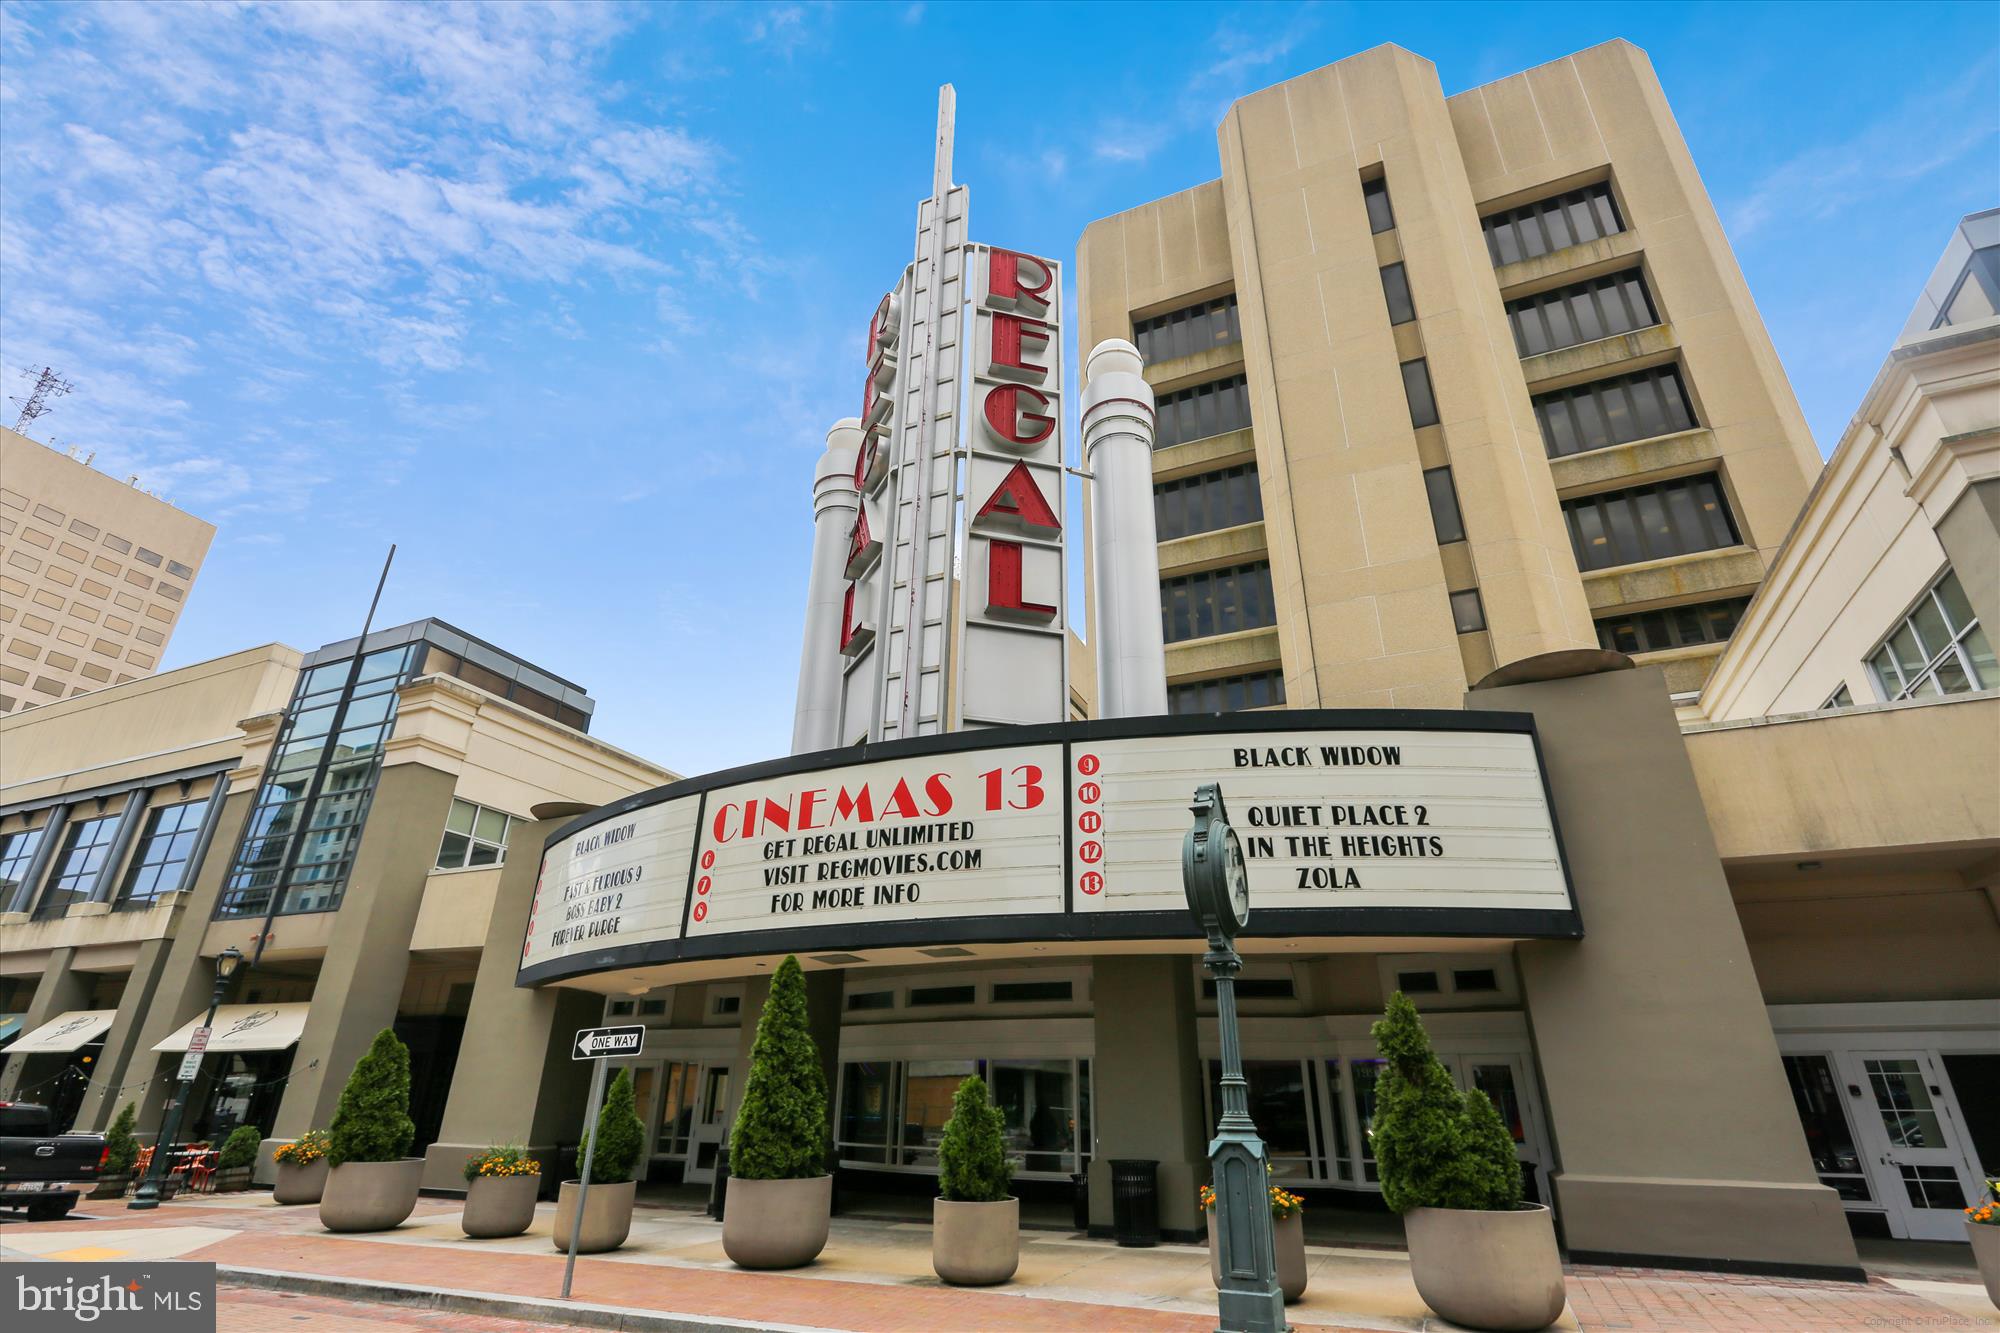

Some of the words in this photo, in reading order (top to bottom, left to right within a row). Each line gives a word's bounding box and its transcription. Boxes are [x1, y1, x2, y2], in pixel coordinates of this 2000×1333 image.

[974, 247, 1063, 622] REGAL
[1233, 746, 1312, 768] BLACK
[1320, 746, 1401, 766] WIDOW
[713, 773, 953, 843] CINEMAS
[978, 765, 1045, 811] 13
[1080, 785, 1099, 801] 10
[1082, 814, 1098, 830] 11
[1247, 805, 1322, 827] QUIET
[1331, 805, 1409, 826] PLACE
[1414, 805, 1430, 826] 2
[603, 823, 637, 846] WIDOW
[763, 839, 797, 860] GET
[802, 831, 859, 856] REGAL
[866, 821, 974, 849] UNLIMITED
[1081, 843, 1100, 860] 12
[1247, 836, 1274, 858] IN
[1284, 836, 1332, 857] THE
[1340, 835, 1444, 857] HEIGHTS
[592, 866, 634, 892] FURIOUS
[635, 865, 643, 882] 9
[763, 864, 809, 887] VISIT
[817, 849, 982, 881] REGMOVIES.COM
[1295, 867, 1362, 889] ZOLA
[1082, 874, 1101, 892] 13
[587, 894, 615, 915] BABY
[615, 892, 623, 910] 2
[770, 892, 804, 914] FOR
[812, 886, 865, 910] MORE
[873, 883, 920, 905] INFO
[588, 916, 621, 939] PURGE
[592, 1037, 610, 1048] ONE
[614, 1036, 635, 1047] WAY
